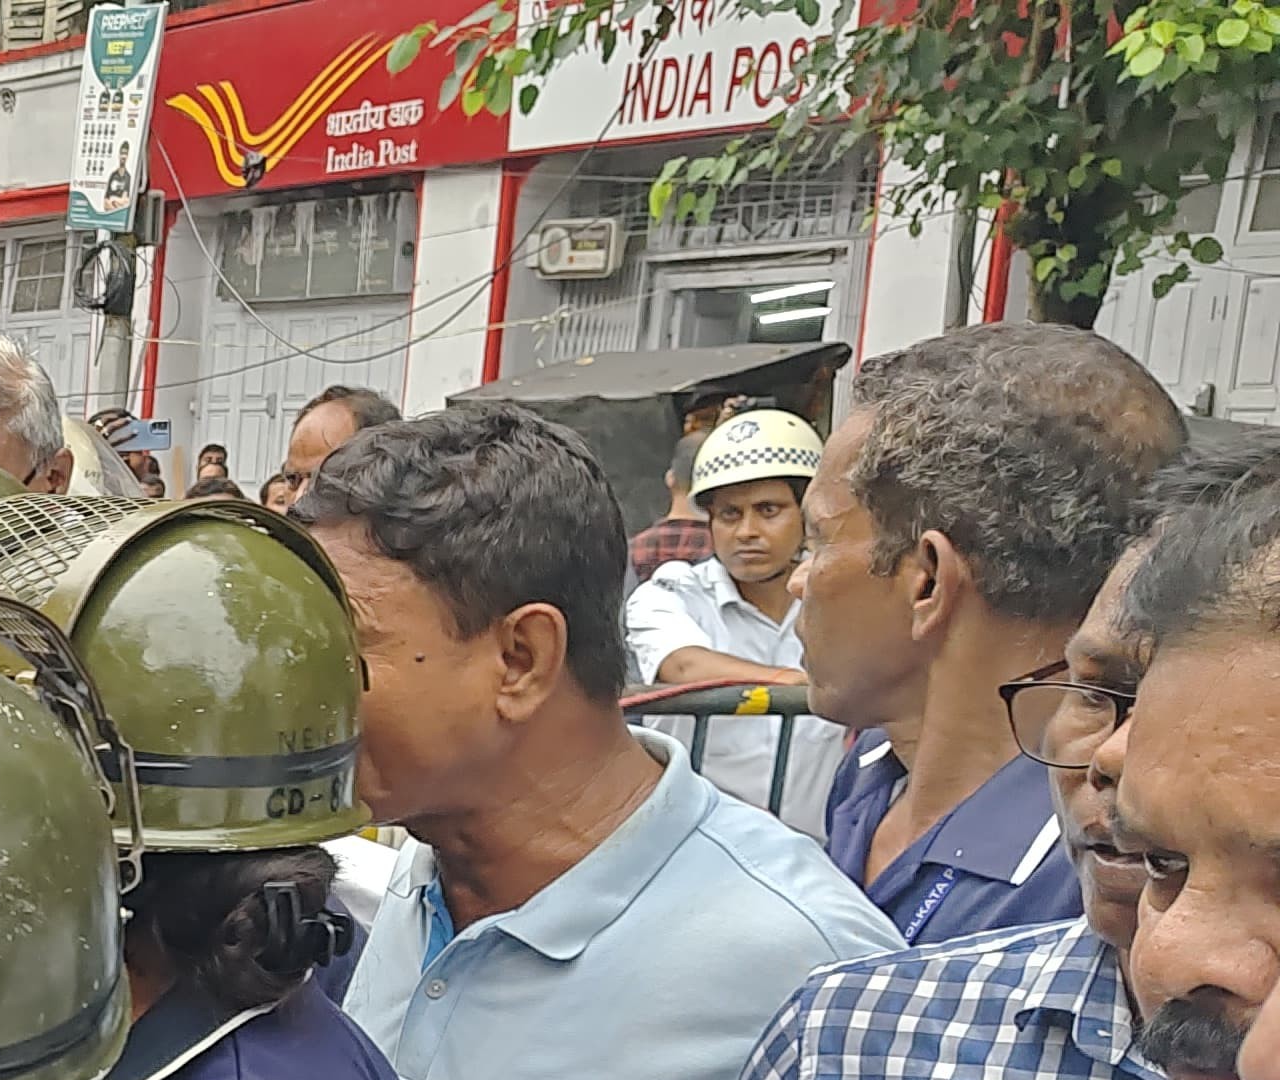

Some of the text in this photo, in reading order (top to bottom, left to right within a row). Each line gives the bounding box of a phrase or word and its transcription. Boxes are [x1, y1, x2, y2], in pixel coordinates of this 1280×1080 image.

[616, 37, 832, 126] INDIA POS
[326, 97, 425, 137] भारतीय डाक
[325, 138, 418, 174] India Post
[903, 882, 950, 942] OLKATA
